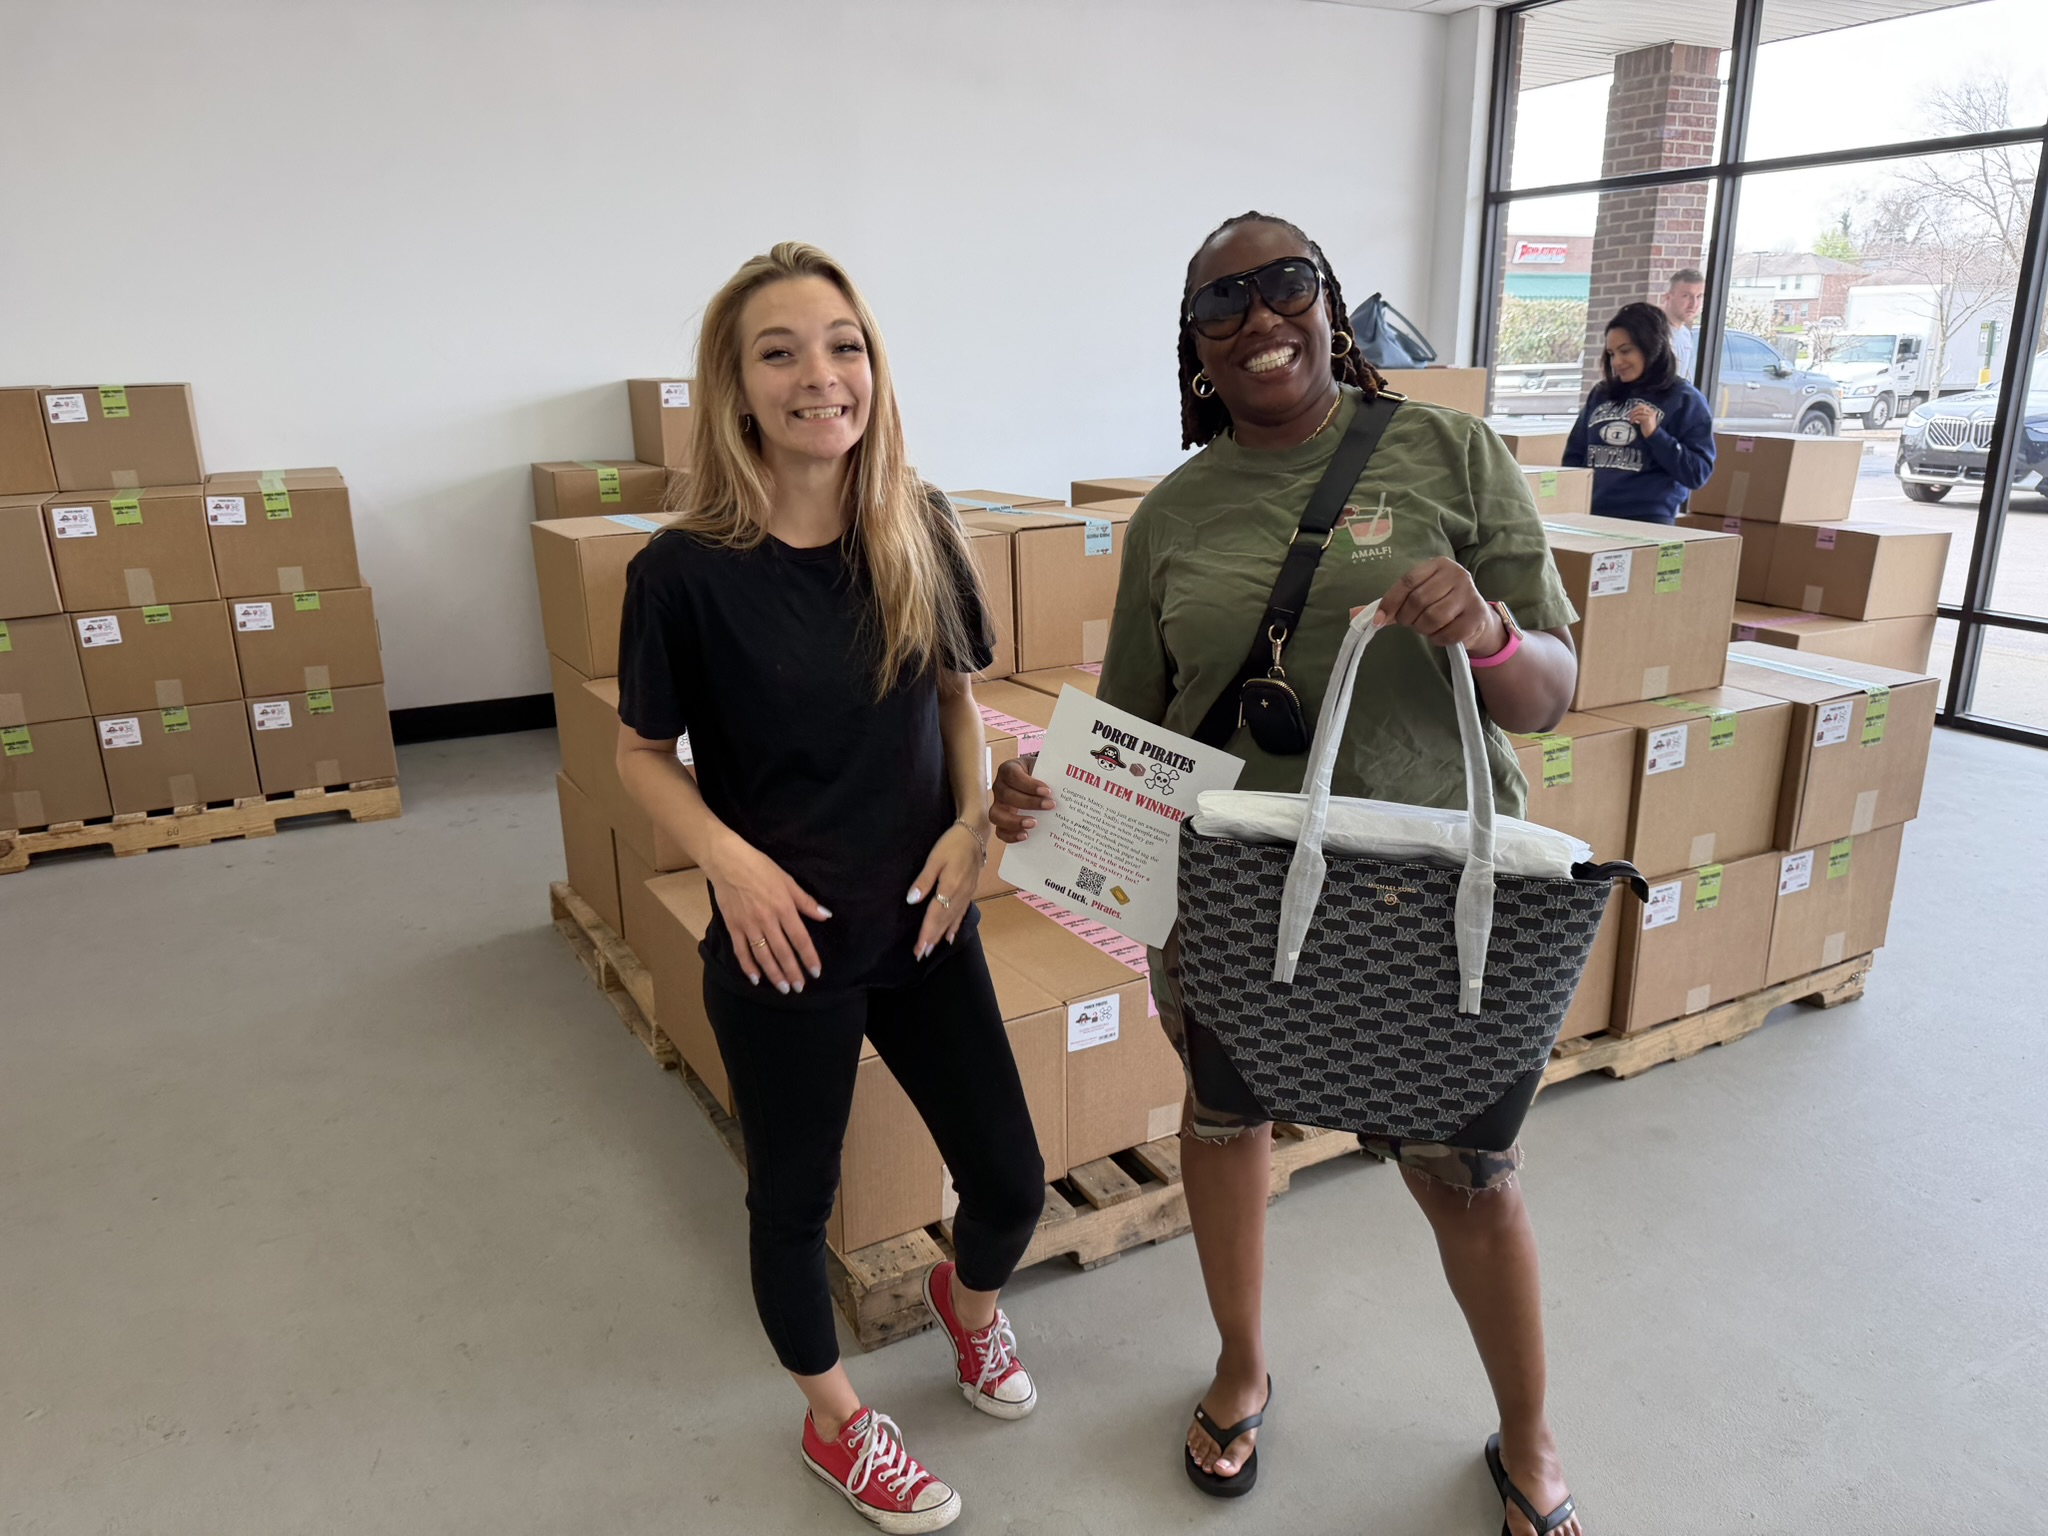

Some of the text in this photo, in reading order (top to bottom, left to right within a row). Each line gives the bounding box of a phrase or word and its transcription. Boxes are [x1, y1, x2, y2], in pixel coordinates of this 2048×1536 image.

[1351, 546, 1392, 560] AMALFI
[1091, 720, 1196, 773] PORCH PIRATES
[1066, 764, 1185, 824] ULTRA ITEM WINNER!
[1045, 879, 1066, 894] Good
[1091, 900, 1121, 919] Pirates.
